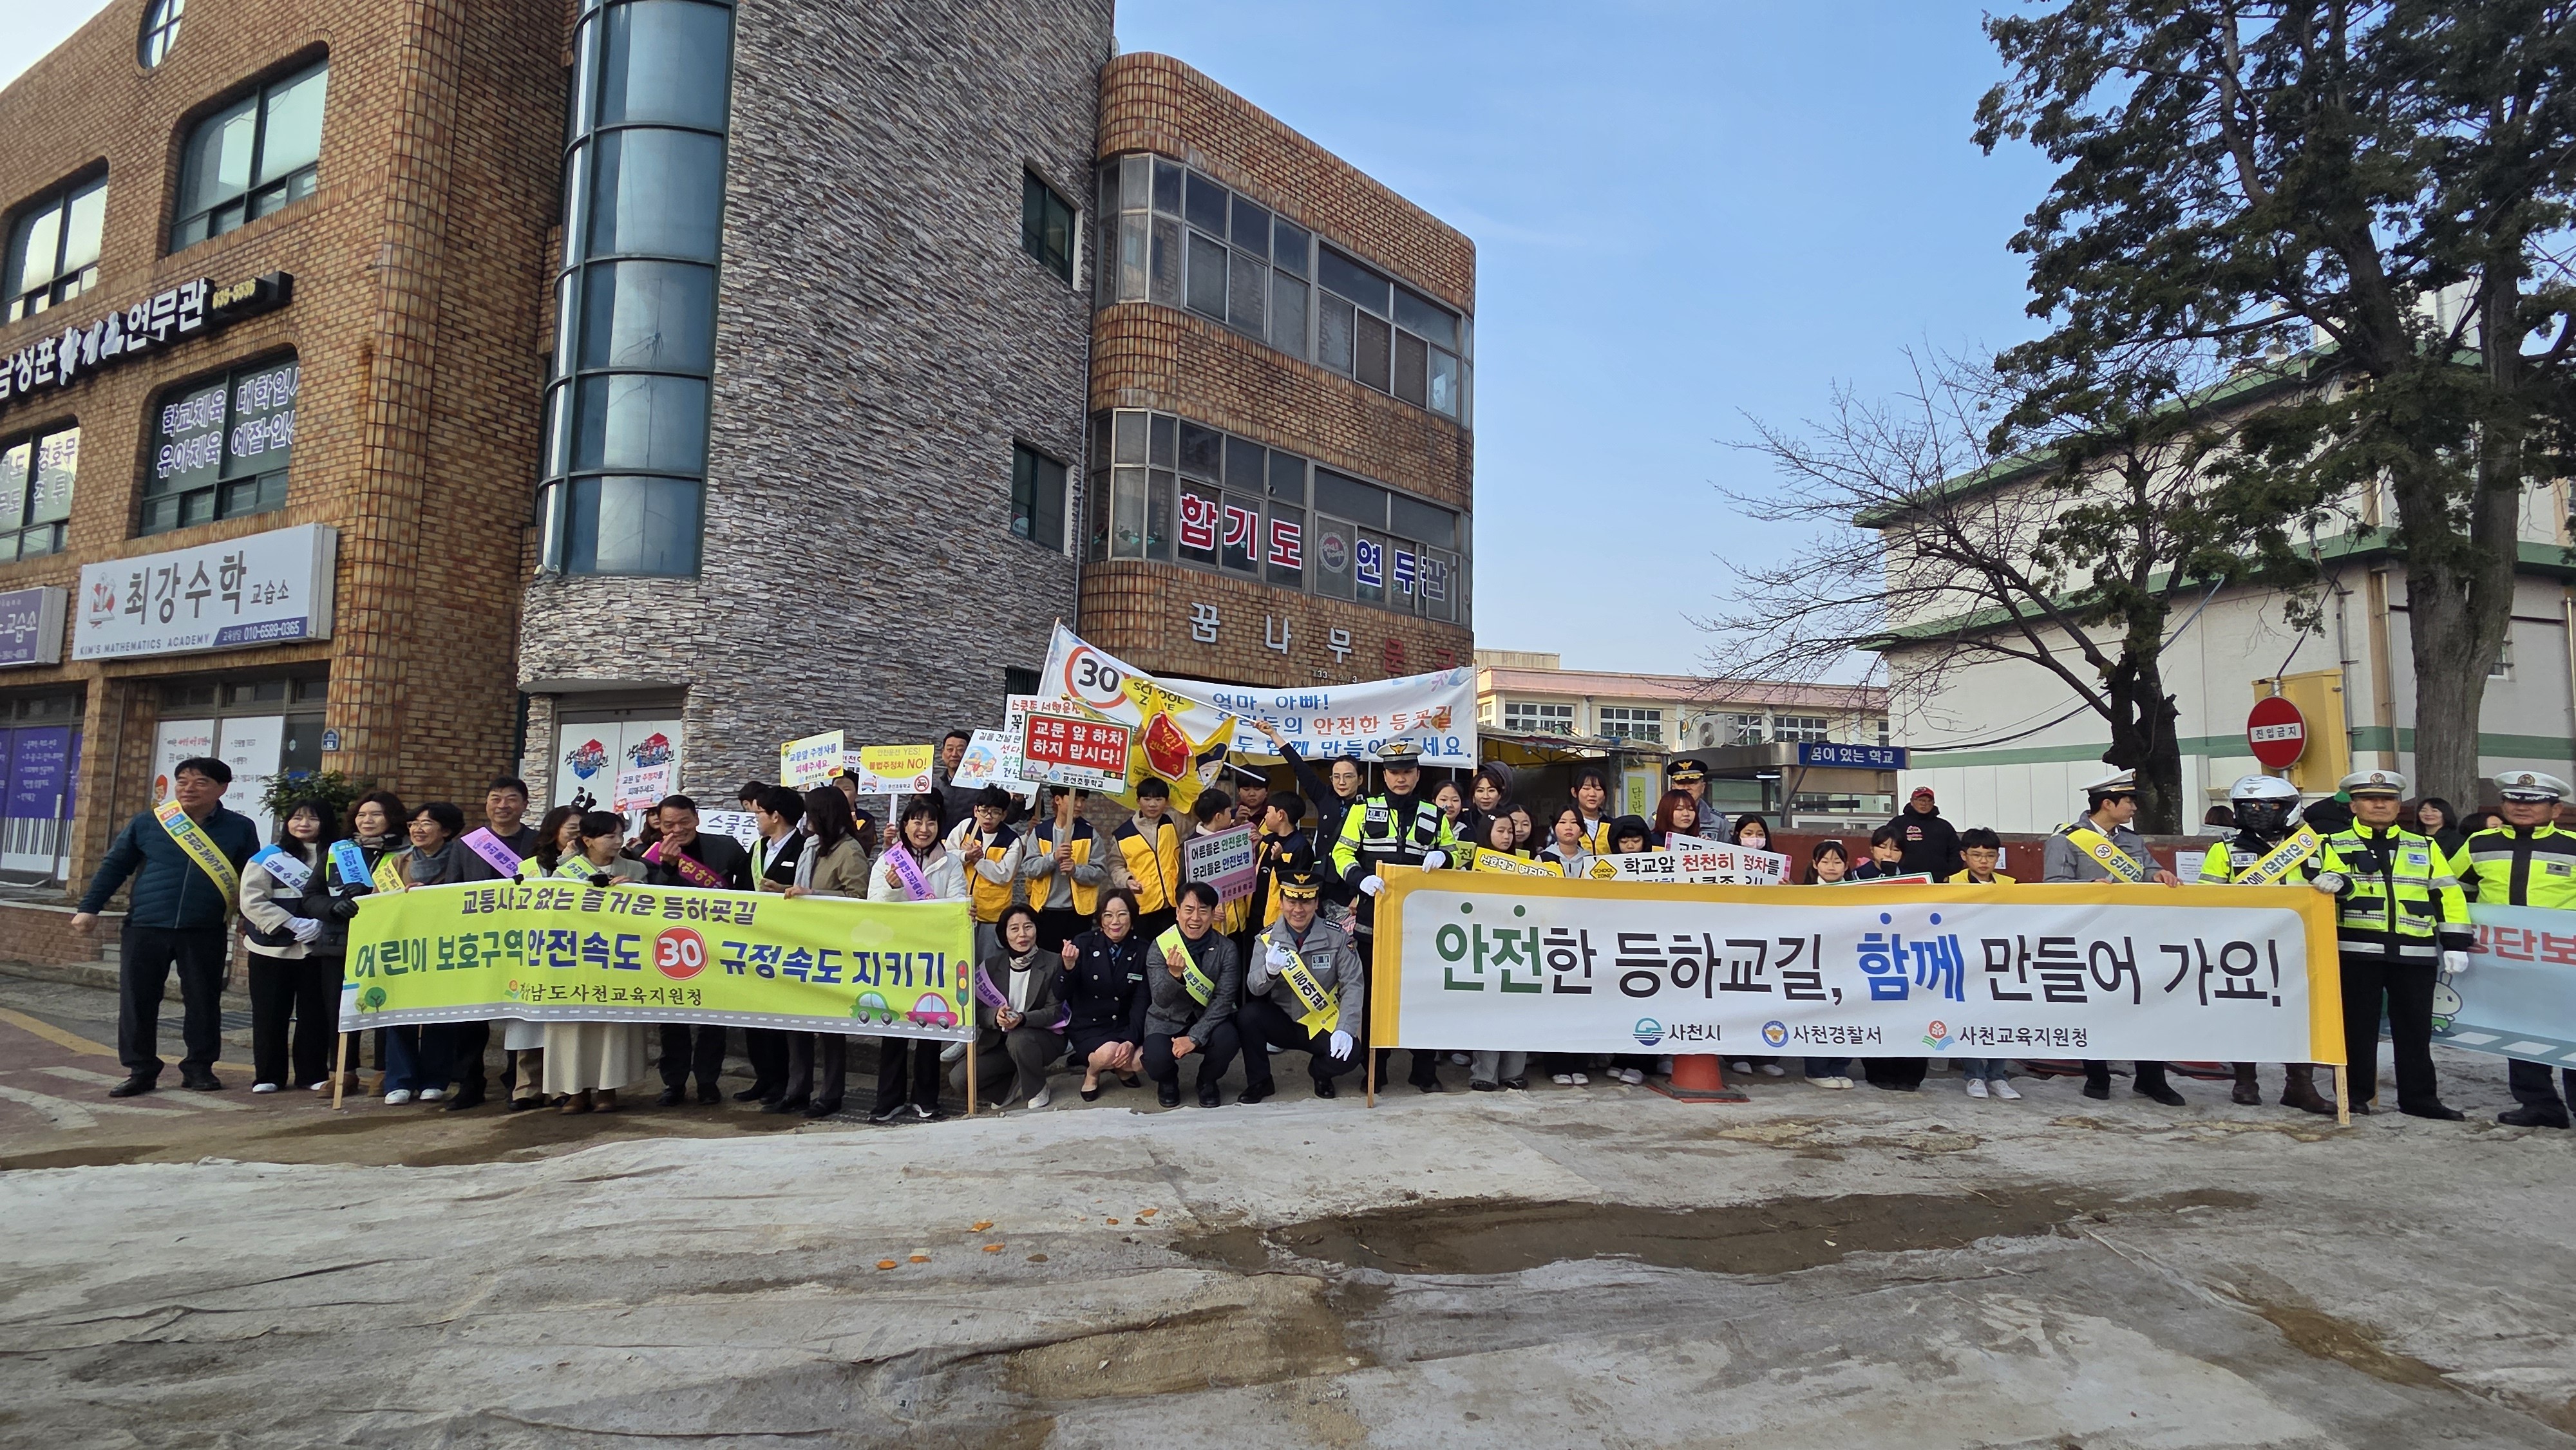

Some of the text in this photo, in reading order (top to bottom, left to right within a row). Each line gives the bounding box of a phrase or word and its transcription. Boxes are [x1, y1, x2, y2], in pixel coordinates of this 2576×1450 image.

[128, 277, 207, 352] 연무관
[162, 389, 225, 437] 학교체육
[157, 431, 222, 478] 유아체육
[1180, 493, 1303, 570] 합기도
[124, 550, 290, 625] 최강수학 교습소
[80, 633, 211, 655] KIM'S MATHEMATICS ACADEMY
[1078, 658, 1119, 692] 30
[1213, 692, 1329, 713] 엄마, 아빠!
[1034, 720, 1123, 748] 교문 앞 하차
[1313, 715, 1381, 736] 안전한
[1389, 705, 1452, 732] 등굣길
[2255, 725, 2297, 740] 진입금지
[810, 742, 837, 759] 주정차를
[869, 761, 904, 770] 불법주정차
[907, 757, 927, 769] NO!
[903, 747, 921, 756] YES!
[1032, 739, 1121, 766] 하지 맙시다!
[1840, 748, 1865, 763] 있는
[1869, 749, 1894, 764] 학교
[1631, 786, 1643, 813] 달란
[707, 814, 757, 836] 스쿨존
[1191, 841, 1220, 860] 어른들은
[2098, 846, 2110, 857] 30
[2301, 836, 2312, 846] 30
[1193, 851, 1250, 881] 우리들은 안전보행
[1624, 852, 1735, 874] 학교앞 천천히
[1743, 854, 1780, 876] 정차를
[2262, 843, 2305, 876] 안전한
[461, 887, 758, 926] 교통사고 없는 즐거운 등하굣길
[355, 936, 428, 979] 어린이
[436, 928, 524, 972] 보호구역
[527, 929, 642, 972] 안전속도
[658, 936, 703, 968] 30
[719, 940, 844, 985] 규정속도
[852, 950, 945, 988] 지키기
[1435, 923, 2282, 1007] 안전한 등하교길, 함께 만들어 가요!
[1668, 1024, 2088, 1049] 사천시 사천경찰서 사천교육지원청
